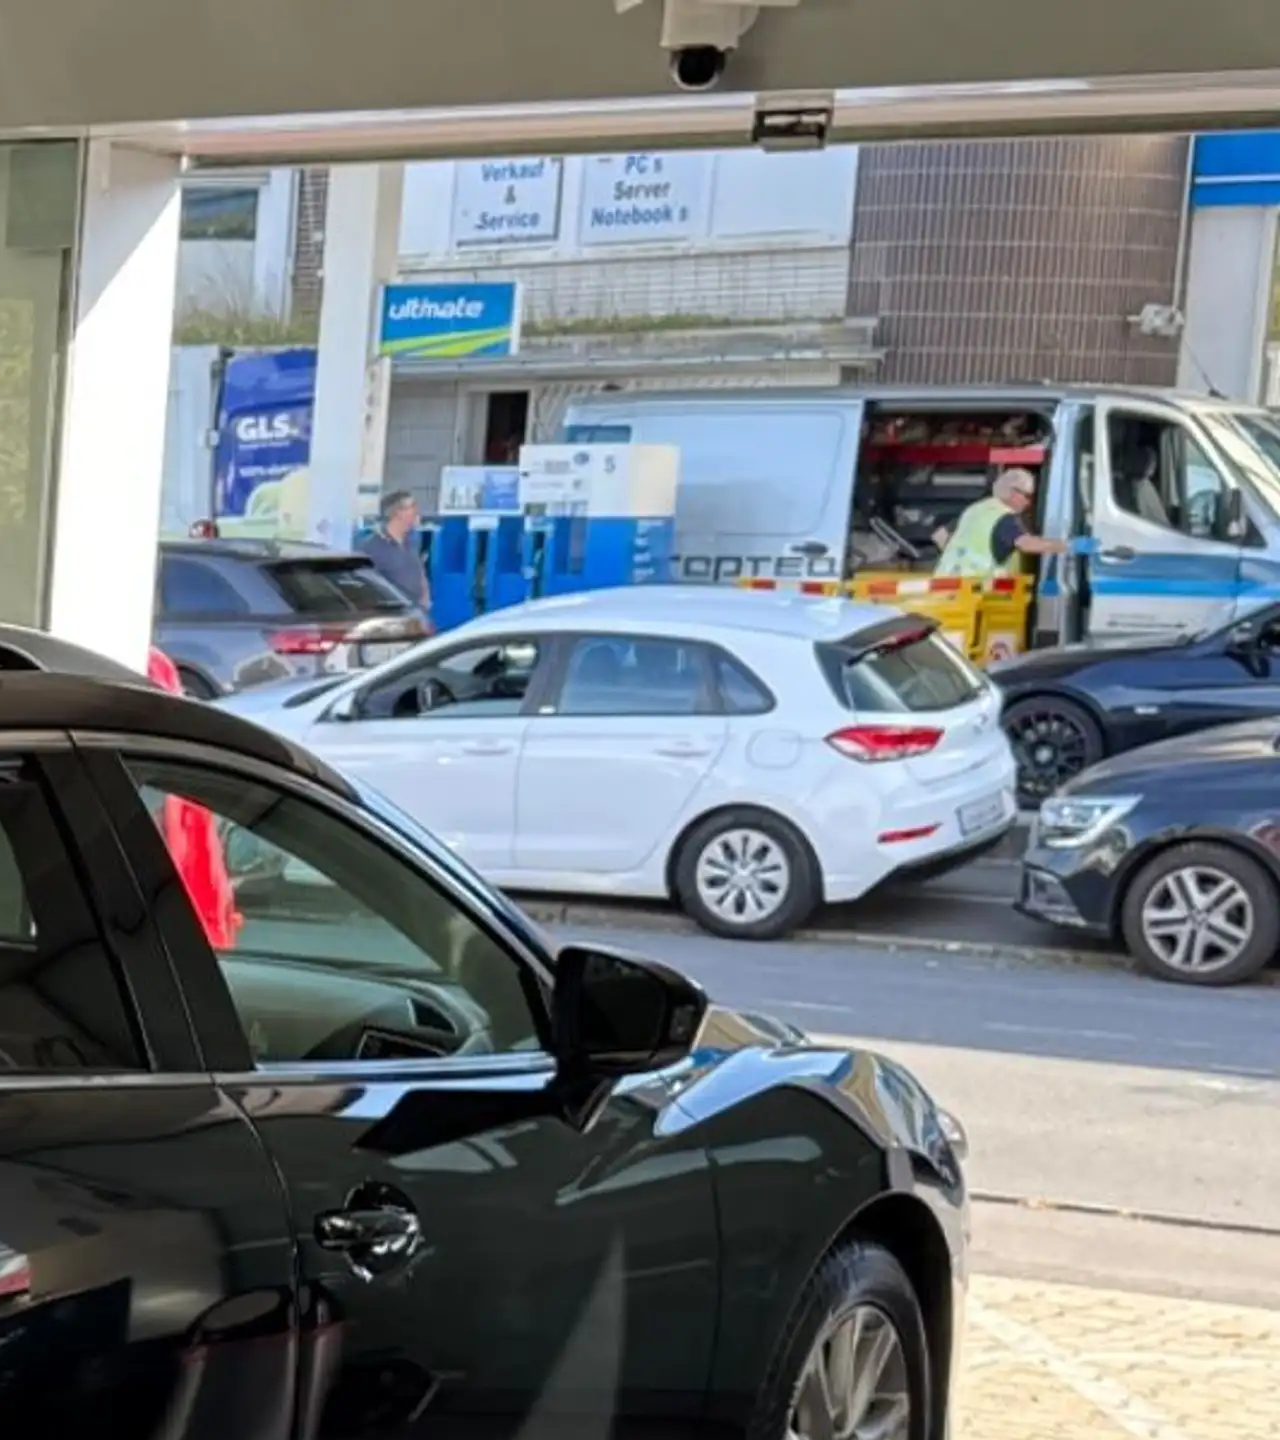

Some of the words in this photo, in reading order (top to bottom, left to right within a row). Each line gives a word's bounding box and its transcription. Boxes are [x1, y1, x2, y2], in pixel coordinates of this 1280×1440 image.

[613, 180, 671, 201] Server
[477, 210, 540, 231] Service
[389, 296, 484, 321] ultimate
